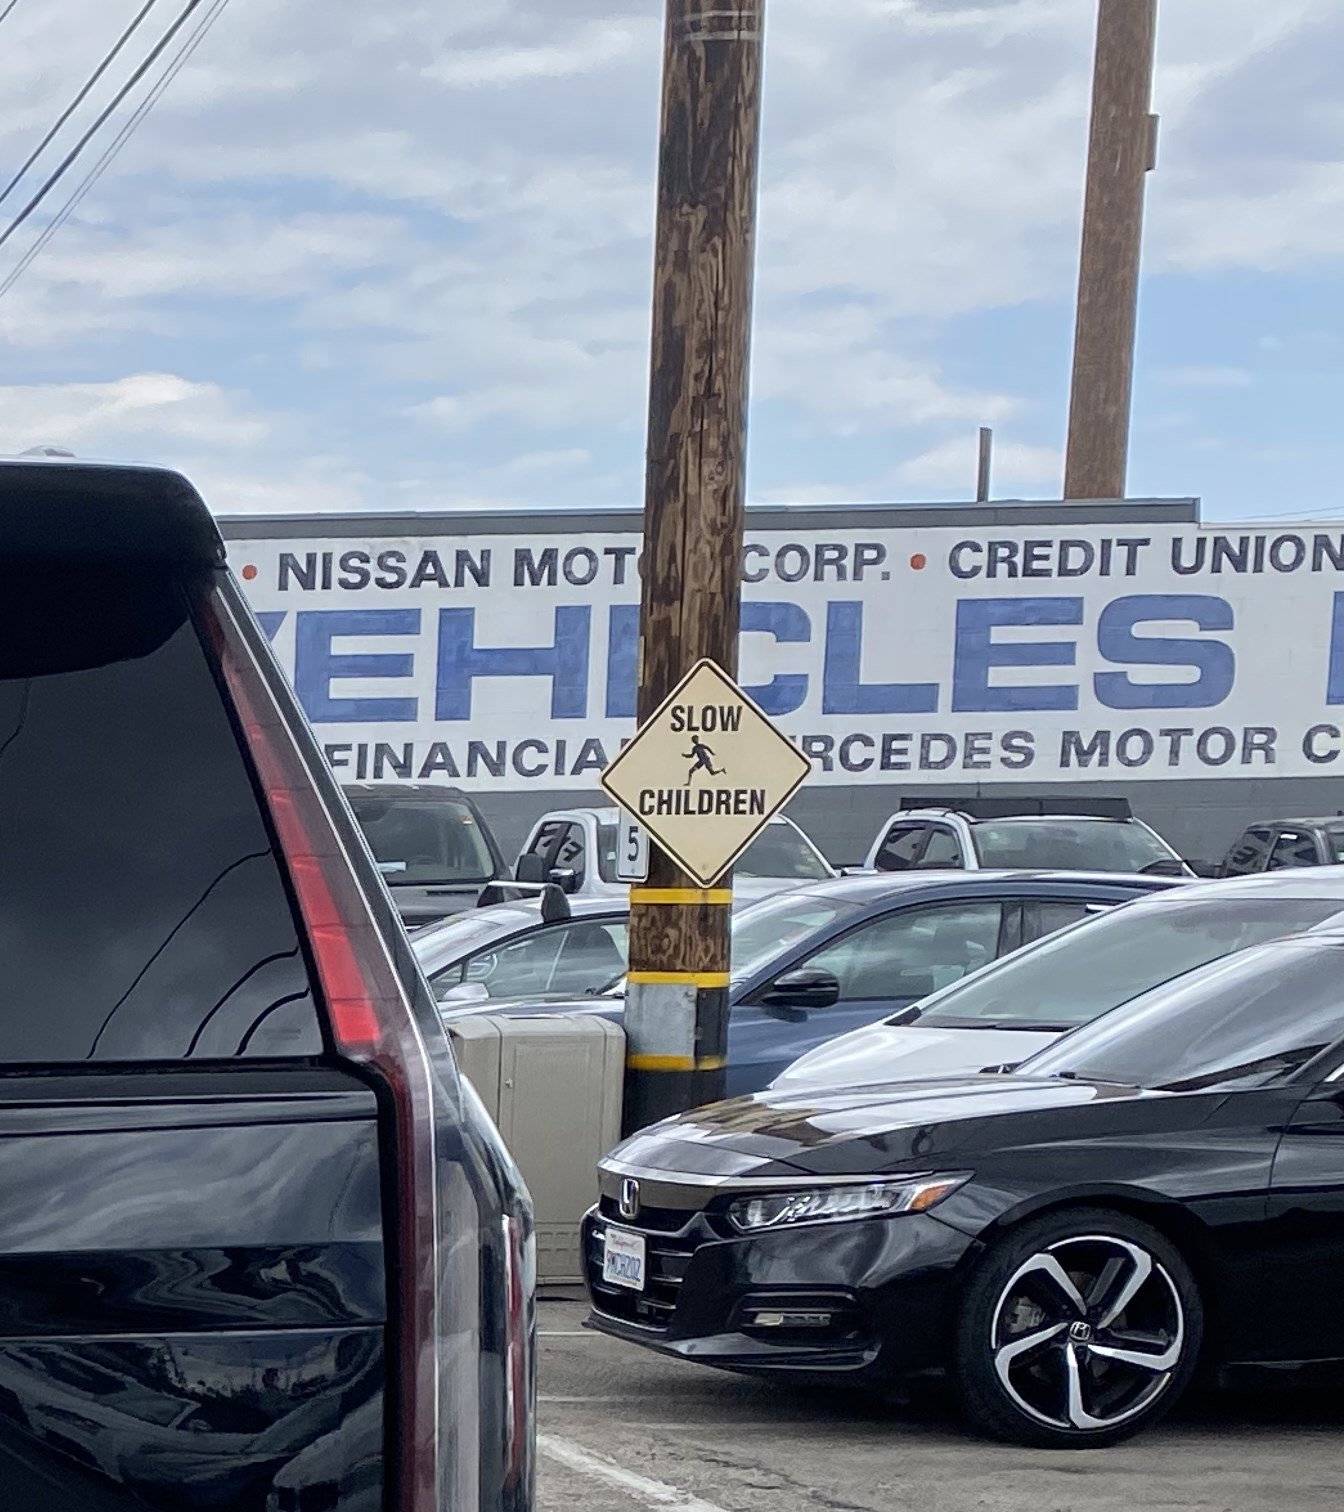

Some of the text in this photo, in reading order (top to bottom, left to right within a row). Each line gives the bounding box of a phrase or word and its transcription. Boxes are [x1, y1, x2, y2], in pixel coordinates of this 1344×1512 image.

[278, 533, 1344, 591] NISSAN MOT CORP. CREDIT UNION
[254, 593, 1235, 723] EHICLES
[669, 704, 743, 733] SLOW
[325, 737, 631, 780] FINANCIA
[790, 729, 1036, 772] RCEDES
[1059, 726, 1278, 769] MOTOR
[638, 788, 767, 817] CHILDREN
[627, 825, 640, 862] 5
